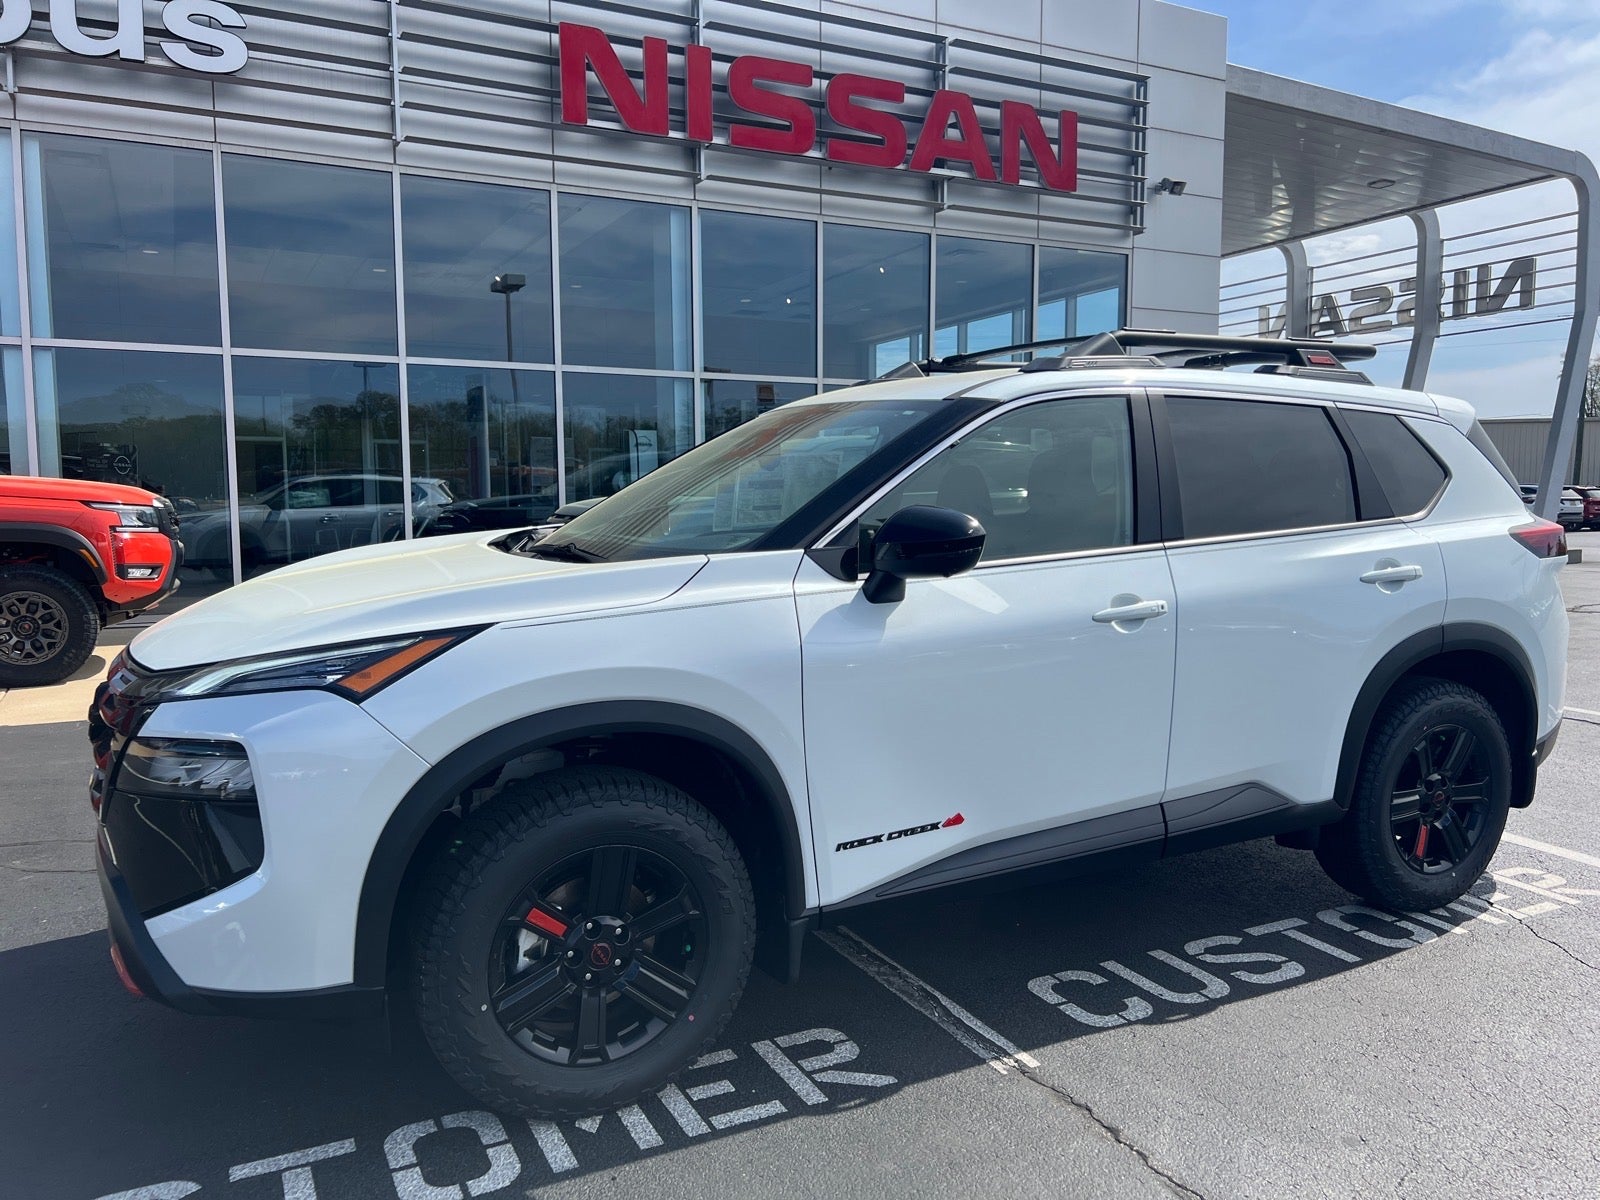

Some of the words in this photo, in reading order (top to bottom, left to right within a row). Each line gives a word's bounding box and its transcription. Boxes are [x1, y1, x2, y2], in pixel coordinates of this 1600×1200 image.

[0, 0, 249, 74] us
[558, 21, 1078, 192] NISSAN
[835, 833, 885, 852] ROCK
[886, 821, 942, 841] CREEK
[1027, 866, 1600, 1028] CUSTOMER
[92, 1027, 898, 1200] TOMER
